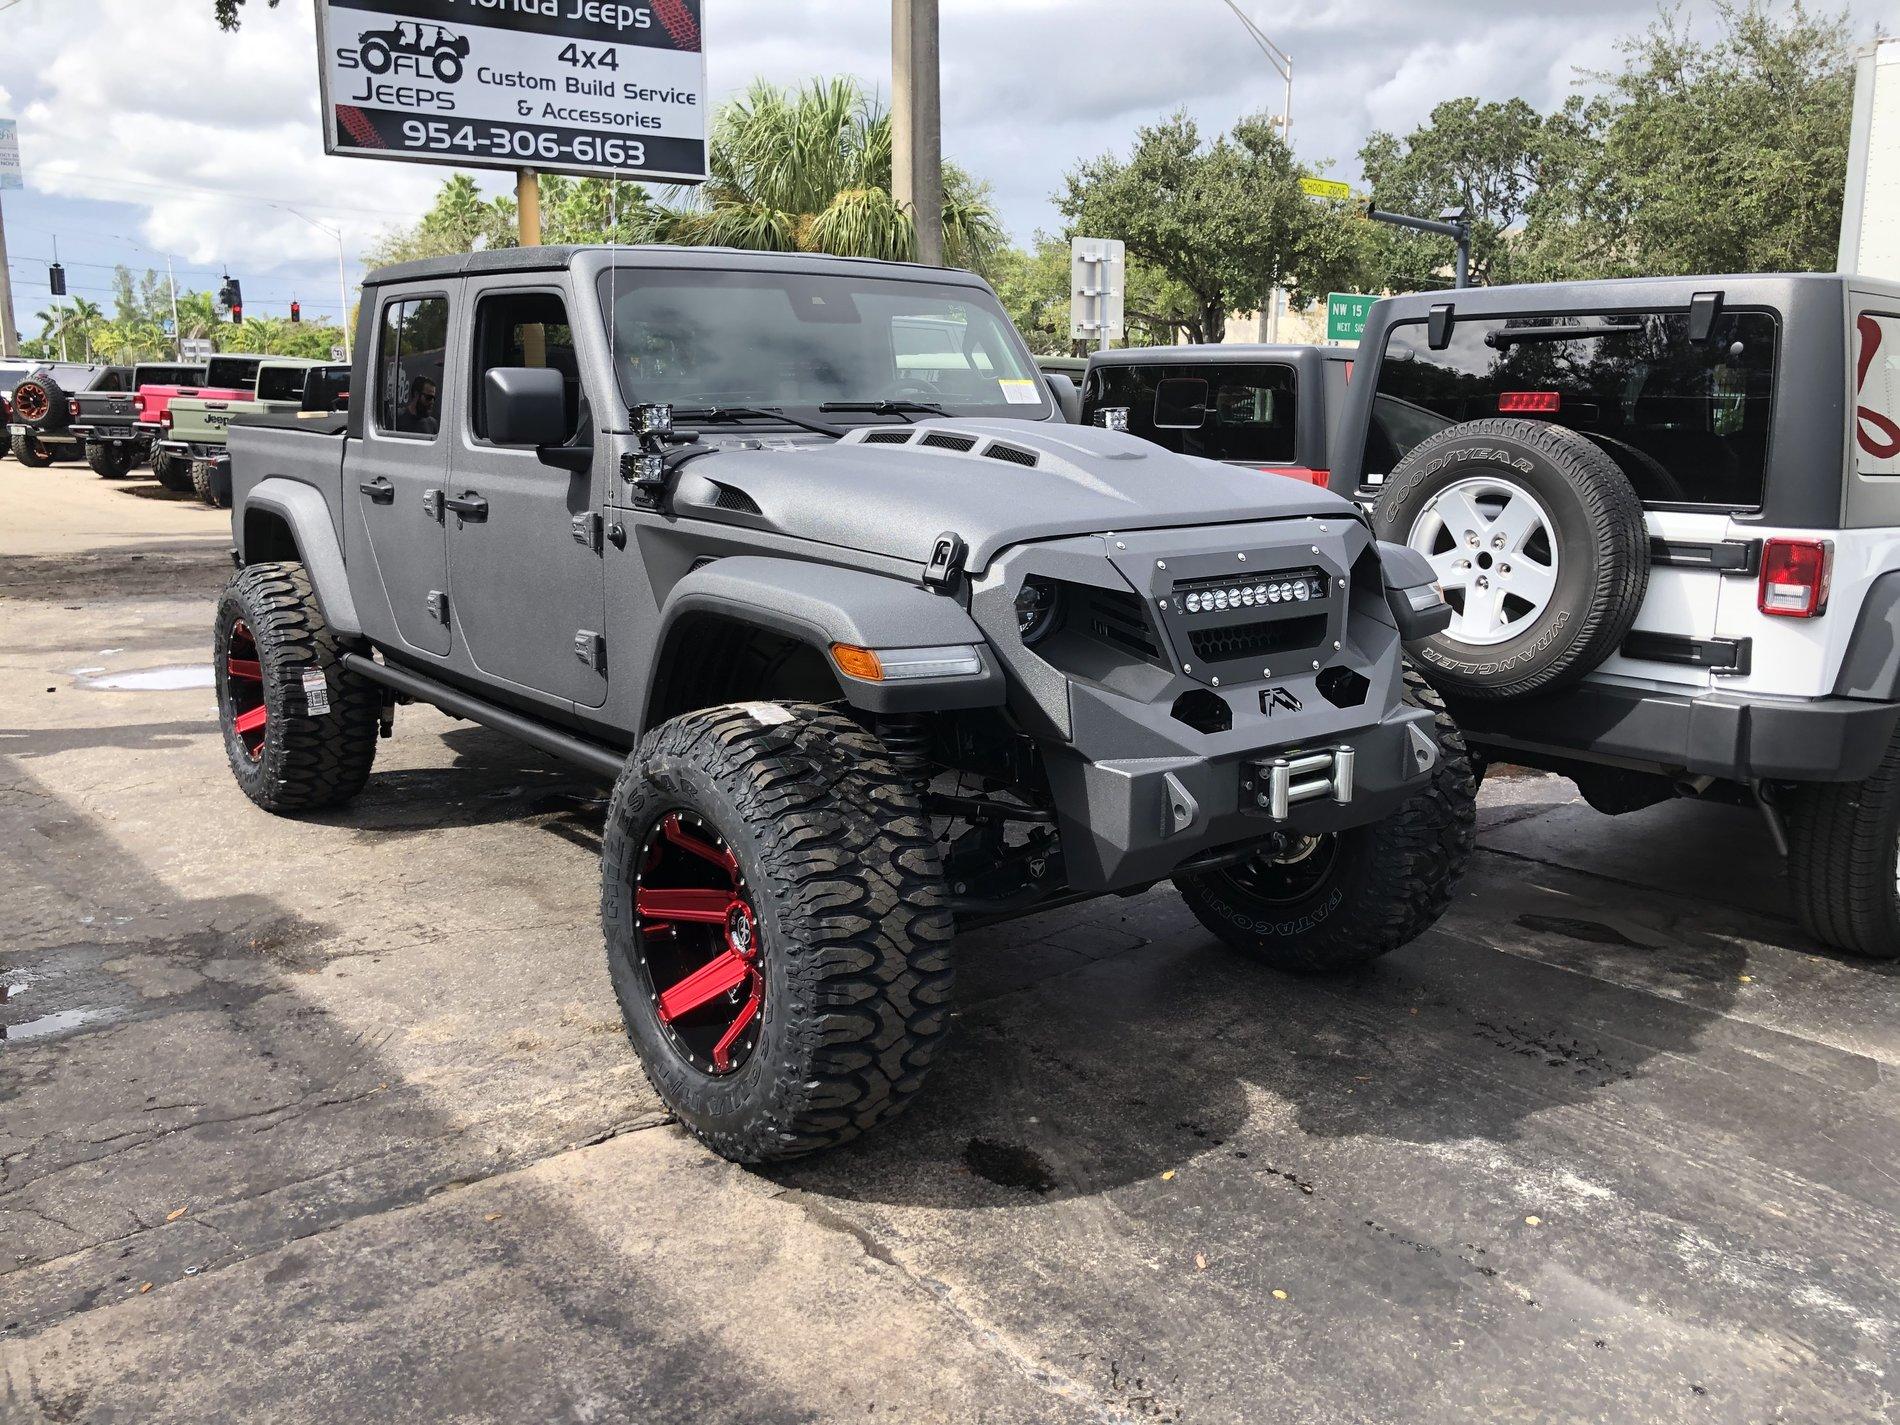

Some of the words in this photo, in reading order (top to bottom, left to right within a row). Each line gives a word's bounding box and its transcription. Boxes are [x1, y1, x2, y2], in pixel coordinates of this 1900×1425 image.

[567, 0, 651, 30] Jeeps
[336, 41, 463, 84] SOFLO
[558, 43, 619, 71] 4x4
[352, 77, 455, 110] JEEPS
[477, 67, 556, 91] Custom
[566, 77, 615, 97] Build
[624, 84, 696, 105] Service
[517, 100, 533, 116] &
[542, 102, 662, 129] Accessories
[402, 120, 645, 165] 954-306-6163
[1301, 181, 1325, 193] CHOOL
[1333, 303, 1348, 316] NW
[1352, 304, 1362, 317] 15
[1337, 322, 1351, 332] NEXT
[204, 413, 230, 426] Jeep
[1386, 448, 1536, 523] GOODYEAR
[1421, 611, 1571, 675] WRANGLER
